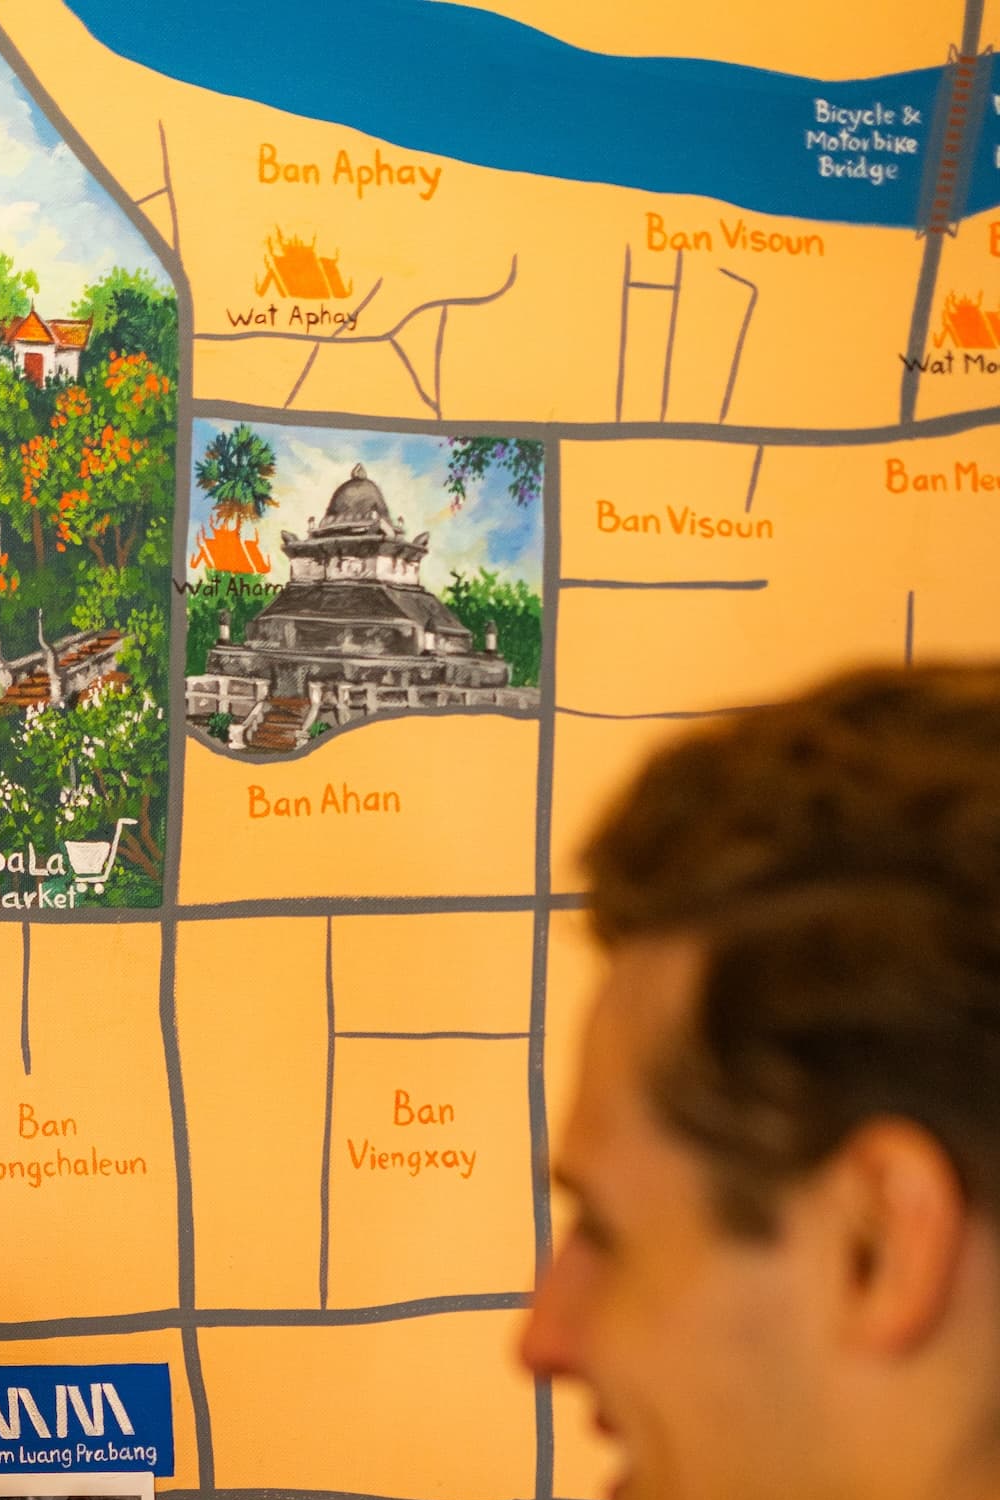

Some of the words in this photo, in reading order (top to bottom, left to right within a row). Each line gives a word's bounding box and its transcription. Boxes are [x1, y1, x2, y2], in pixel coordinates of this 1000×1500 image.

[814, 98, 896, 132] Bicycle
[903, 105, 922, 125] &
[258, 142, 320, 184] Ban
[333, 148, 442, 201] Aphay
[818, 155, 898, 185] Bridge
[646, 212, 712, 252] Ban
[719, 218, 826, 256] Visoun
[225, 303, 278, 327] Wat
[289, 303, 359, 334] Aphay
[898, 350, 953, 375] Wat
[964, 353, 1000, 374] Mo
[885, 457, 947, 494] Ban
[954, 461, 1000, 493] Me
[596, 500, 661, 534] Ban
[666, 504, 774, 539] Visoun
[172, 577, 221, 597] Wat
[248, 784, 312, 819] Ban
[321, 782, 401, 814] Ahan
[18, 1102, 77, 1139] Ban
[393, 1088, 455, 1126] Ban
[347, 1138, 476, 1179] Viengxay
[19, 1446, 73, 1469] Luang
[76, 1441, 158, 1466] Prabang
